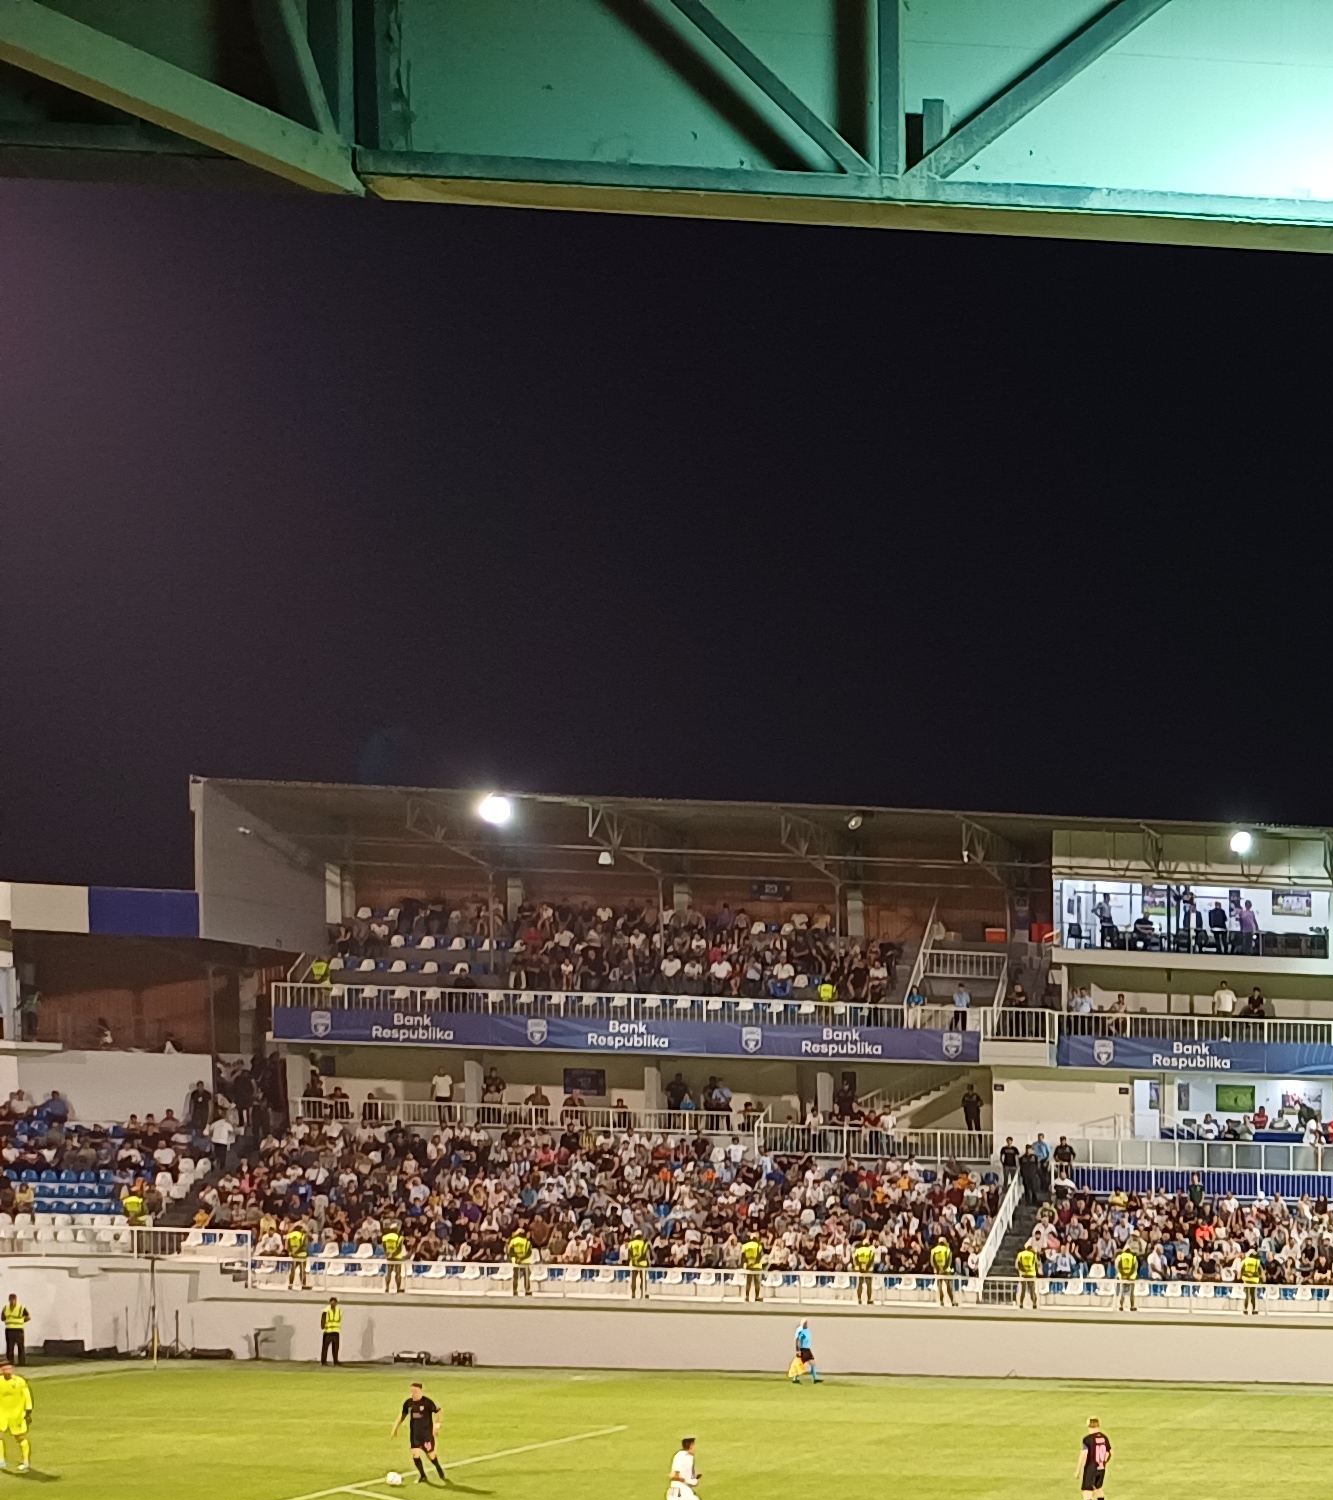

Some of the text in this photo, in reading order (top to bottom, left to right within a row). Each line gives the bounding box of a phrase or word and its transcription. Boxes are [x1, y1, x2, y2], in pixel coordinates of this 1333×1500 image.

[393, 1013, 432, 1027] Bank
[608, 1020, 647, 1035] Bank
[372, 1025, 454, 1041] Respublika
[822, 1027, 860, 1042] Bank
[587, 1033, 669, 1050] Respublika
[801, 1040, 882, 1057] Respublika
[1173, 1041, 1210, 1055] Bank
[1152, 1053, 1231, 1069] Respublika
